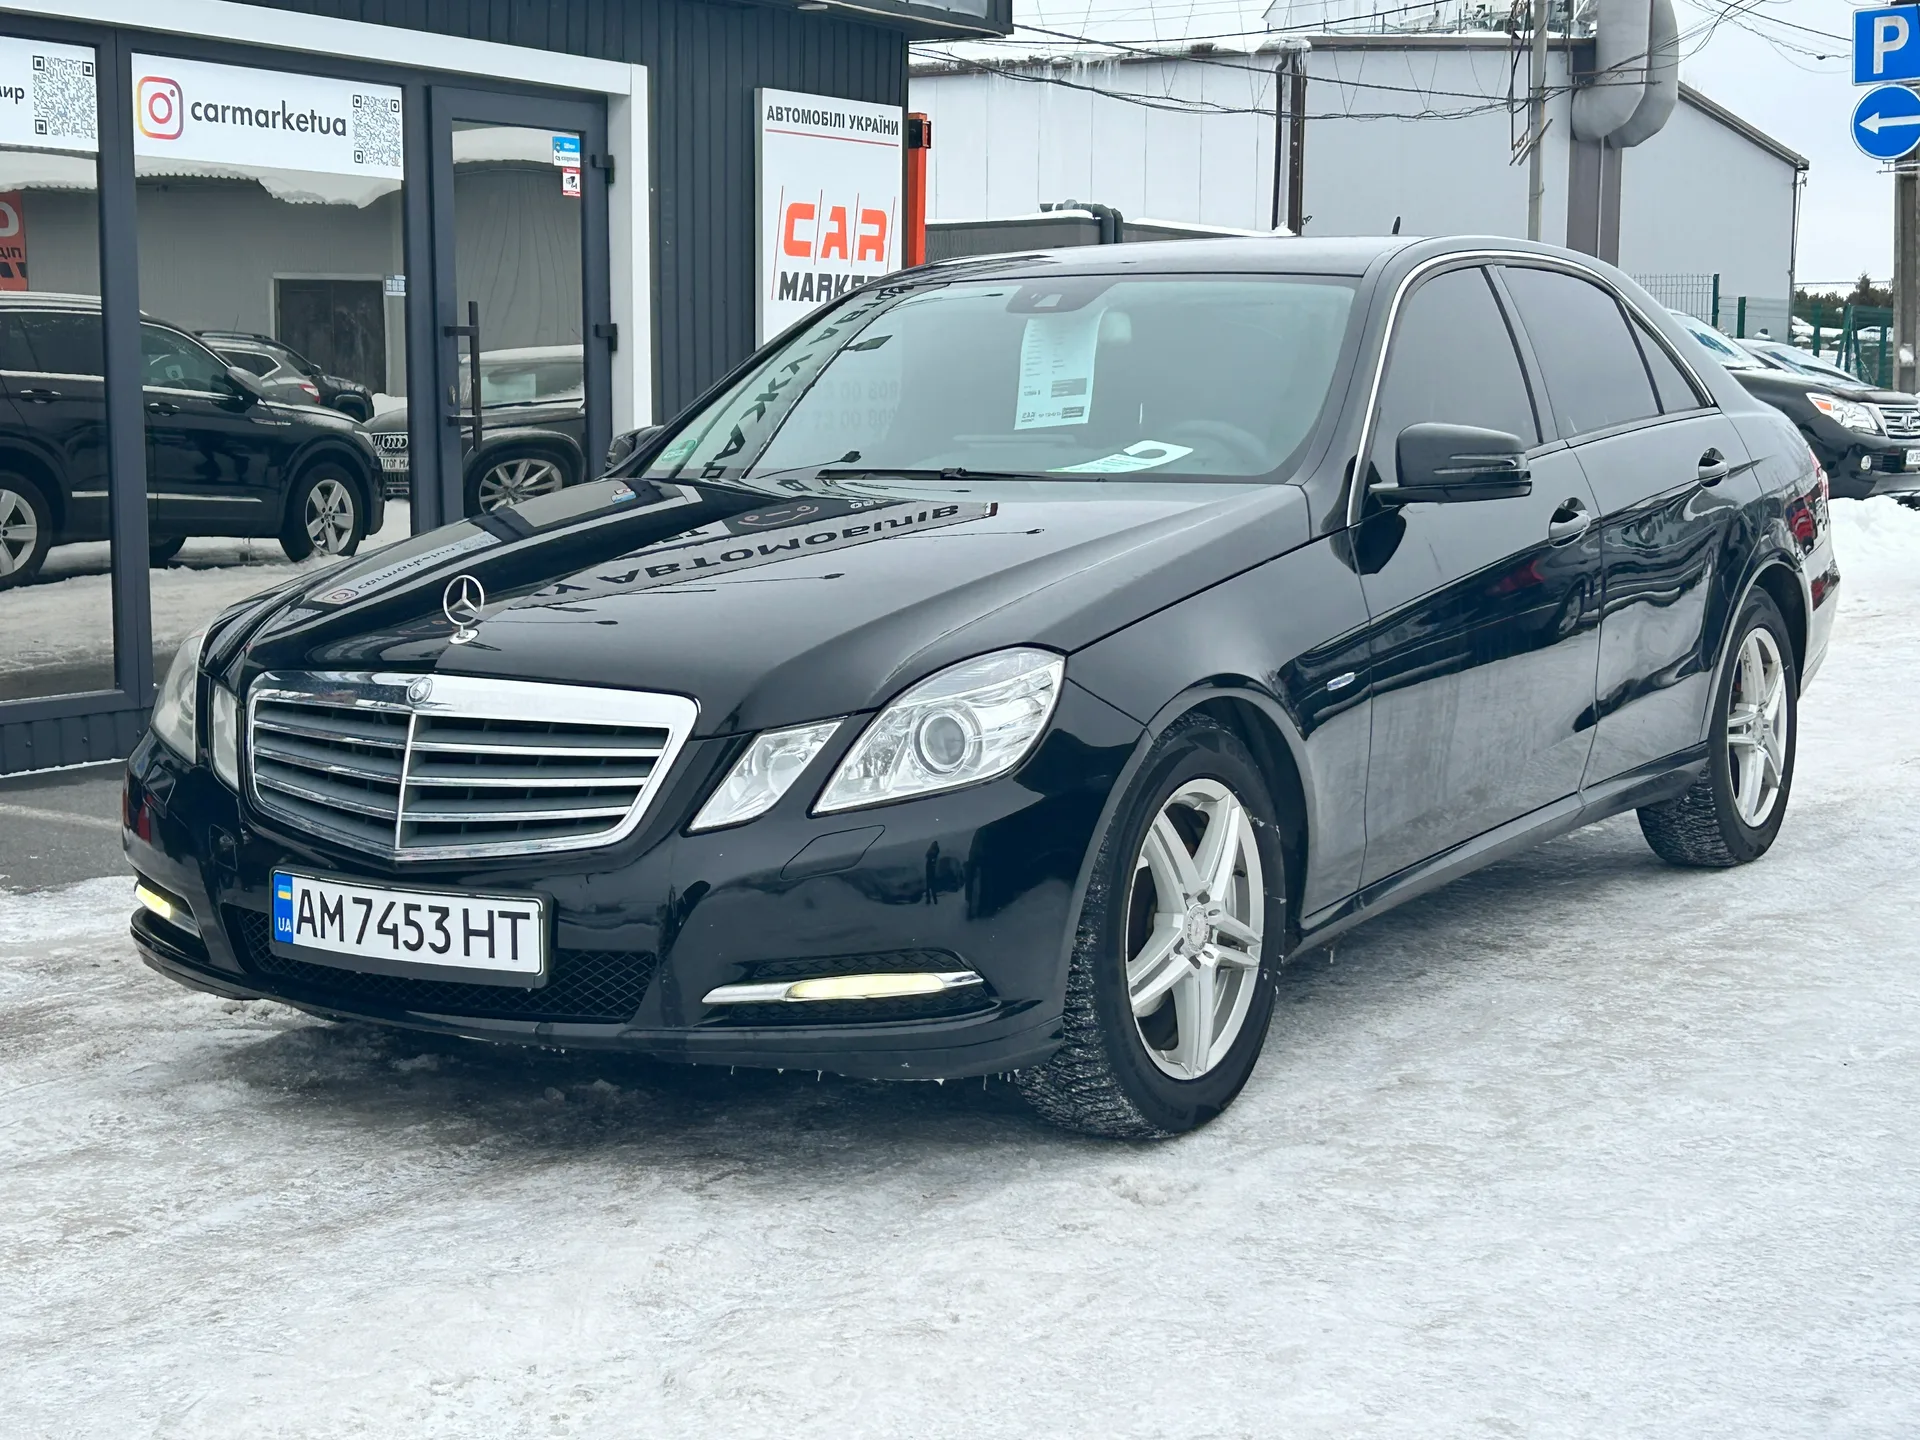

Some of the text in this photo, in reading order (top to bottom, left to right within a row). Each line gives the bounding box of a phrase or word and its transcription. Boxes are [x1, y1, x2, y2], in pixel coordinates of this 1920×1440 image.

[1873, 15, 1909, 74] P
[0, 86, 25, 105] ир
[191, 100, 347, 136] carmarketua
[767, 105, 899, 136] АВТОМОБІЛІ УКРАЇНИ
[783, 202, 888, 262] CAR
[779, 271, 882, 302] MARK
[277, 917, 292, 932] UA
